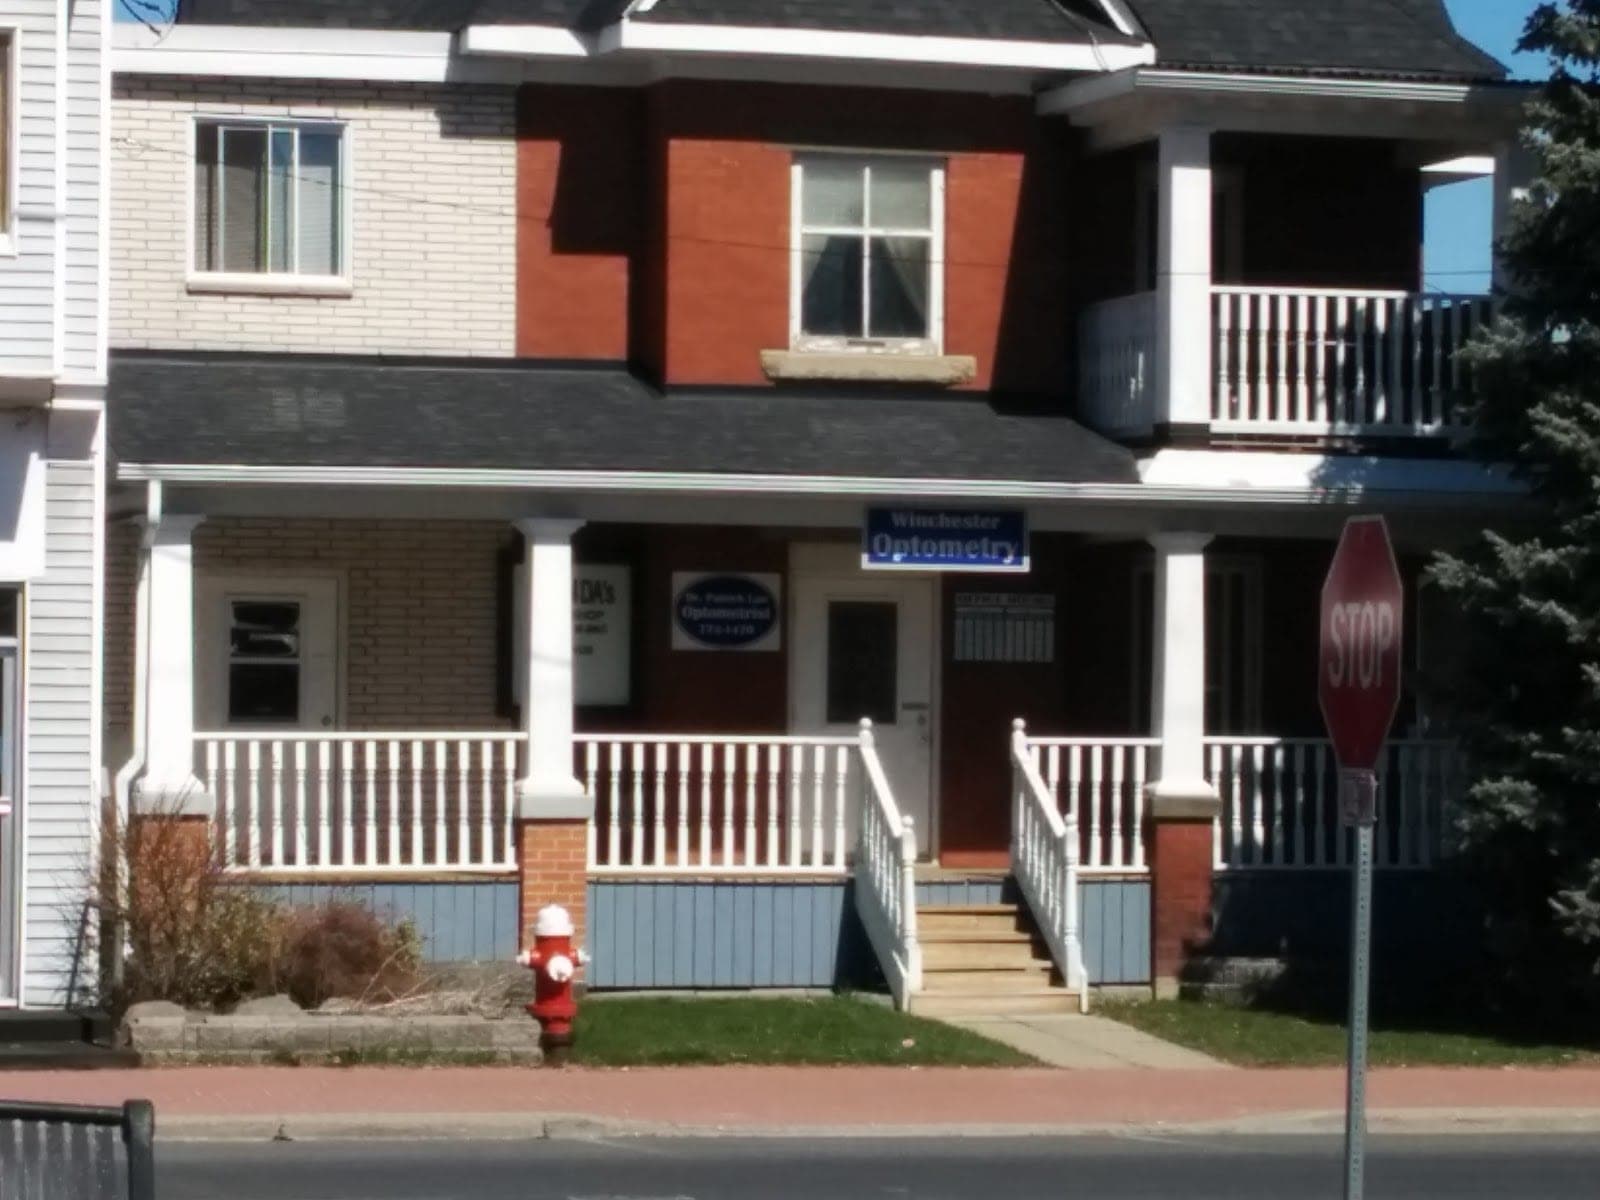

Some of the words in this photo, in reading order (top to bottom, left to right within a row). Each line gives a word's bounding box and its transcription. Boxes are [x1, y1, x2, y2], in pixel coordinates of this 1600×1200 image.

[891, 512, 1001, 529] Winchester
[872, 532, 1019, 564] Optometry
[681, 606, 770, 620] Optometrist
[1328, 601, 1393, 688] STOP
